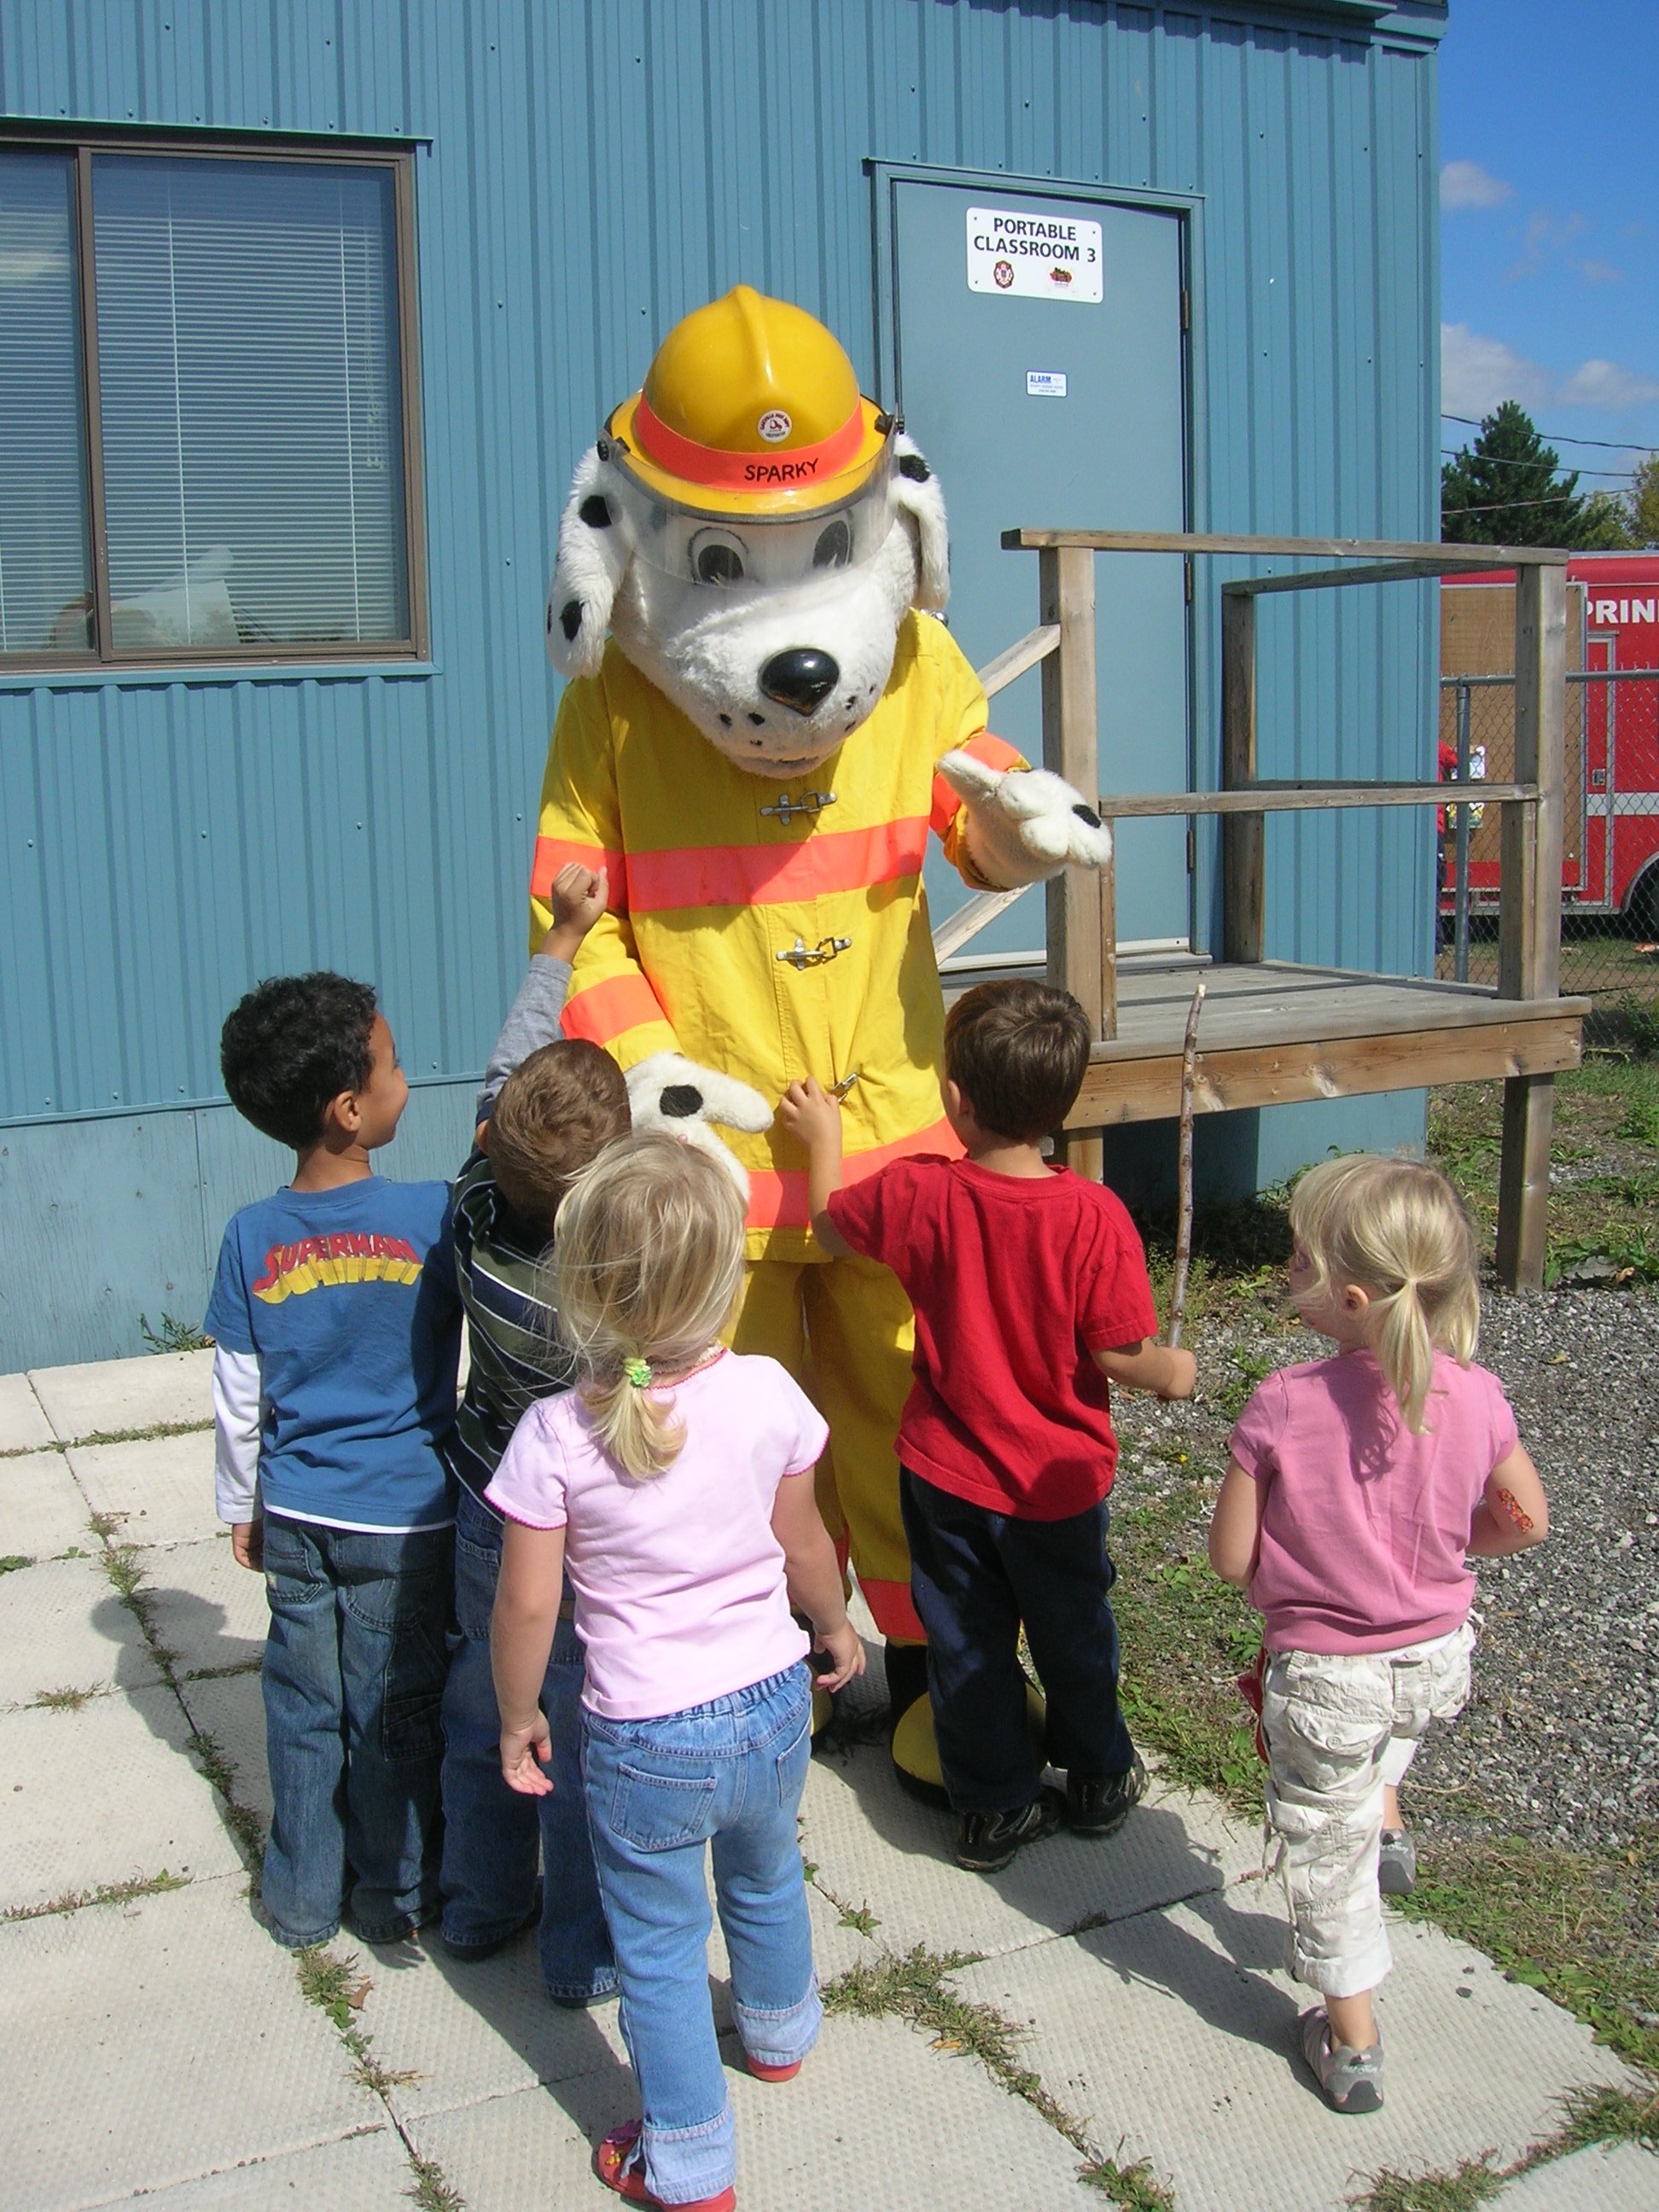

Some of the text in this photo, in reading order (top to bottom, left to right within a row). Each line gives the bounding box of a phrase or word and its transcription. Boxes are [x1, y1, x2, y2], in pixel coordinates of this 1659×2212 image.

[993, 217, 1076, 242] PORTABLE
[974, 235, 1096, 263] CLASSROOM 3
[1030, 375, 1051, 383] ALARM
[745, 458, 818, 482] SPARKY
[1586, 599, 1659, 624] RIN
[253, 1231, 424, 1304] SUPERMAN
